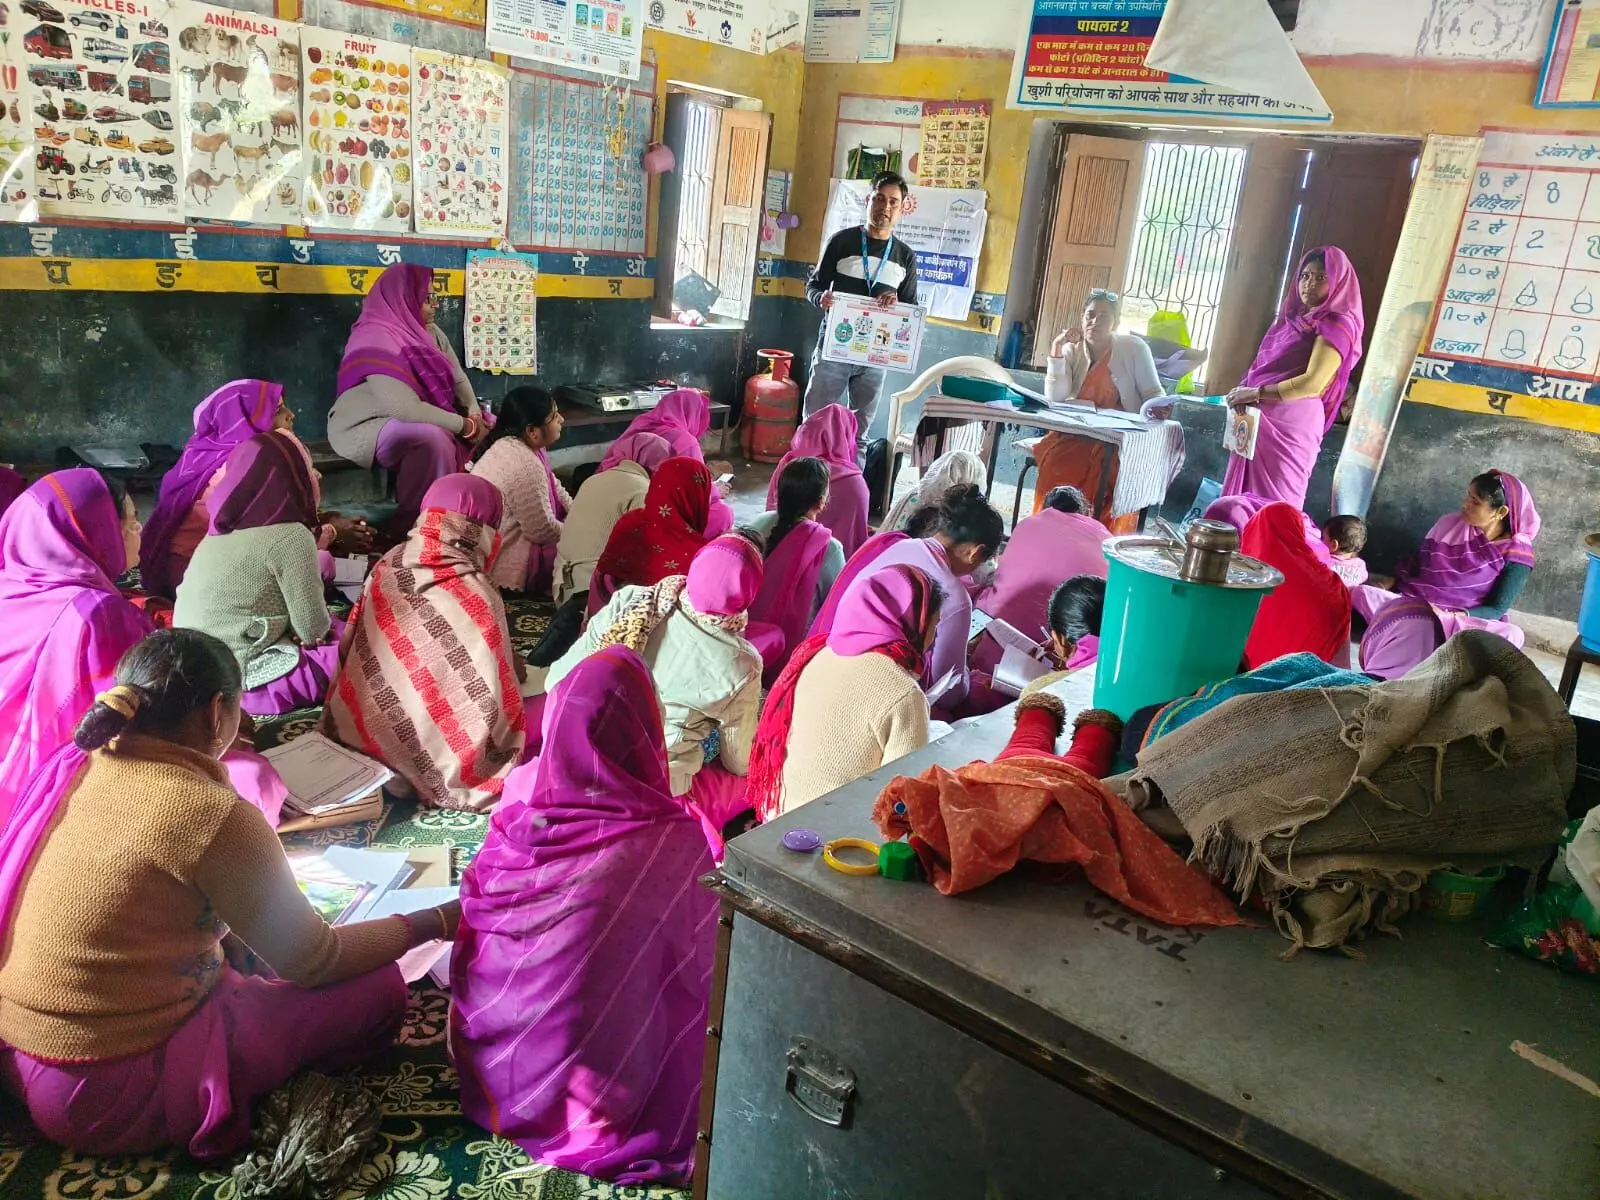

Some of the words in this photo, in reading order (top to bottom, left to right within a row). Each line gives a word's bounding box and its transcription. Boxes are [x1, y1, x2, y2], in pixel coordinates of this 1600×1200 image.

[64, 0, 148, 16] CLES-I
[204, 12, 278, 37] ANIMALS-I
[1077, 20, 1119, 32] पायलट
[1120, 20, 1129, 32] 2
[344, 40, 377, 55] FRUIT
[1109, 55, 1117, 63] 2
[1028, 82, 1053, 100] खुशी
[1055, 83, 1105, 100] परियोजना
[1107, 85, 1124, 100] को
[1125, 87, 1161, 102] आपके
[1163, 90, 1189, 104] साथ
[1191, 88, 1215, 105] और
[564, 137, 576, 148] 20
[549, 150, 562, 160] 20
[564, 151, 576, 161] 25
[563, 166, 575, 177] 30
[548, 179, 560, 189] 28
[562, 180, 574, 192] 35
[1479, 172, 1490, 188] 8
[1547, 181, 1560, 204] 8
[533, 192, 545, 202] 24
[562, 194, 574, 205] 40
[631, 201, 642, 212] 80
[562, 209, 574, 220] 45
[604, 211, 614, 221] 72
[631, 214, 642, 225] 90
[532, 221, 545, 232] 30
[547, 223, 559, 233] 40
[561, 223, 573, 235] 50
[576, 225, 587, 236] 60
[589, 225, 600, 237] 70
[602, 225, 614, 236] 80
[616, 227, 628, 238] 90
[630, 228, 644, 240] 100
[1467, 220, 1479, 231] 2
[1488, 219, 1509, 235] से
[1526, 229, 1545, 249] 2
[290, 239, 315, 264] उ
[626, 254, 647, 277] ओ
[256, 265, 280, 290] च
[760, 278, 771, 294] ट
